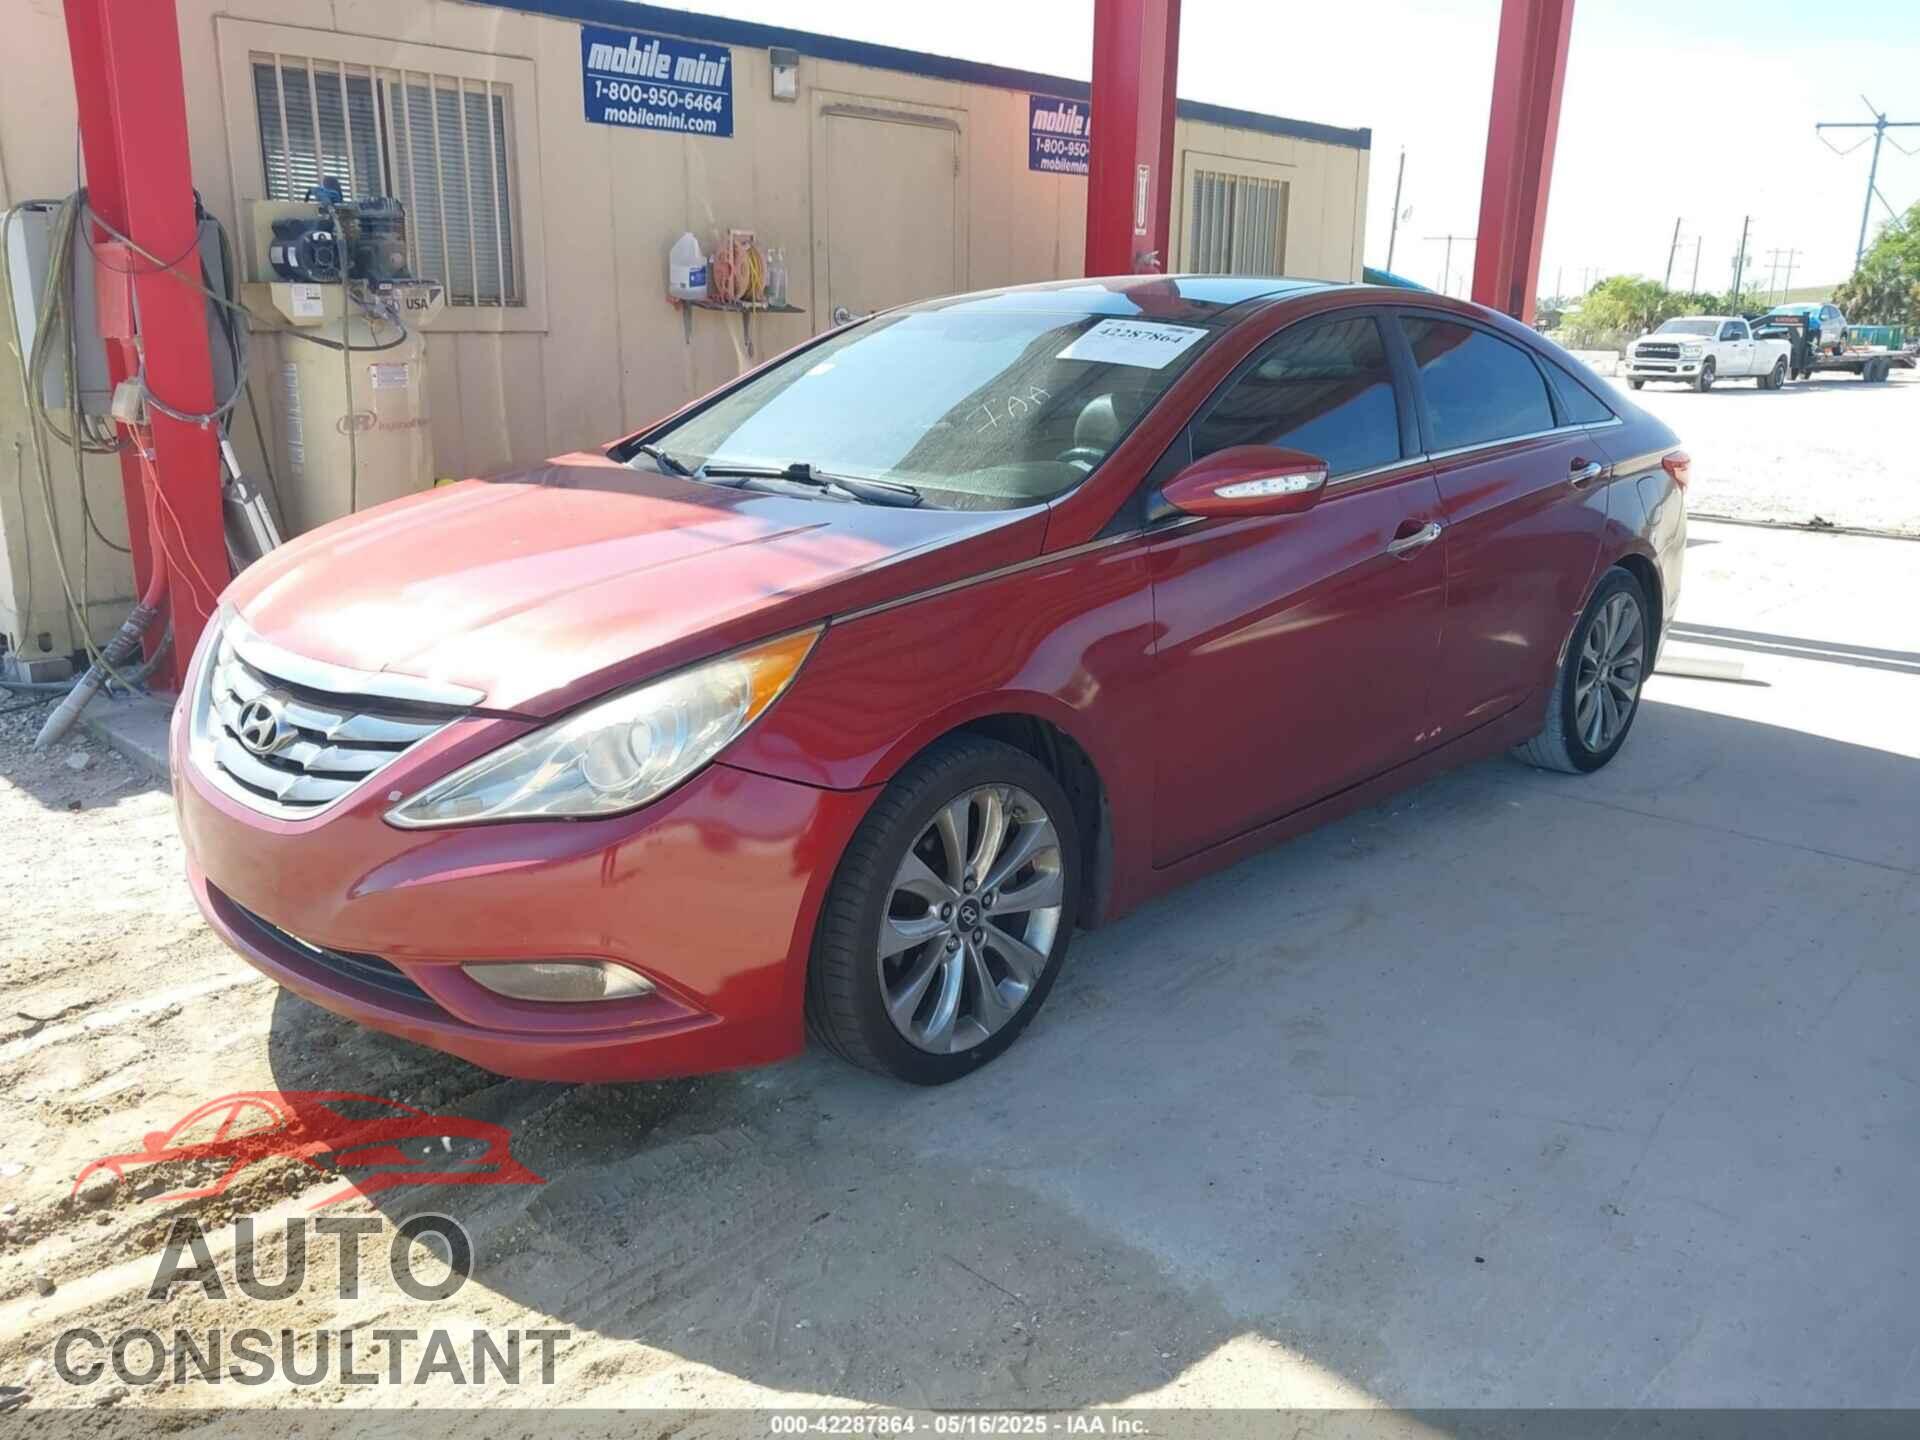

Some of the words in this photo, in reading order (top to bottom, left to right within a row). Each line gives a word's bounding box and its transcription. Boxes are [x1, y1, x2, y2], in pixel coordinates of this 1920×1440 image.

[587, 36, 671, 79] mobile
[674, 53, 727, 87] mini
[595, 80, 722, 113] 1-800-950-6464
[604, 106, 717, 133] mobilemini.com
[1032, 102, 1084, 136] mobile
[406, 298, 428, 310] USA
